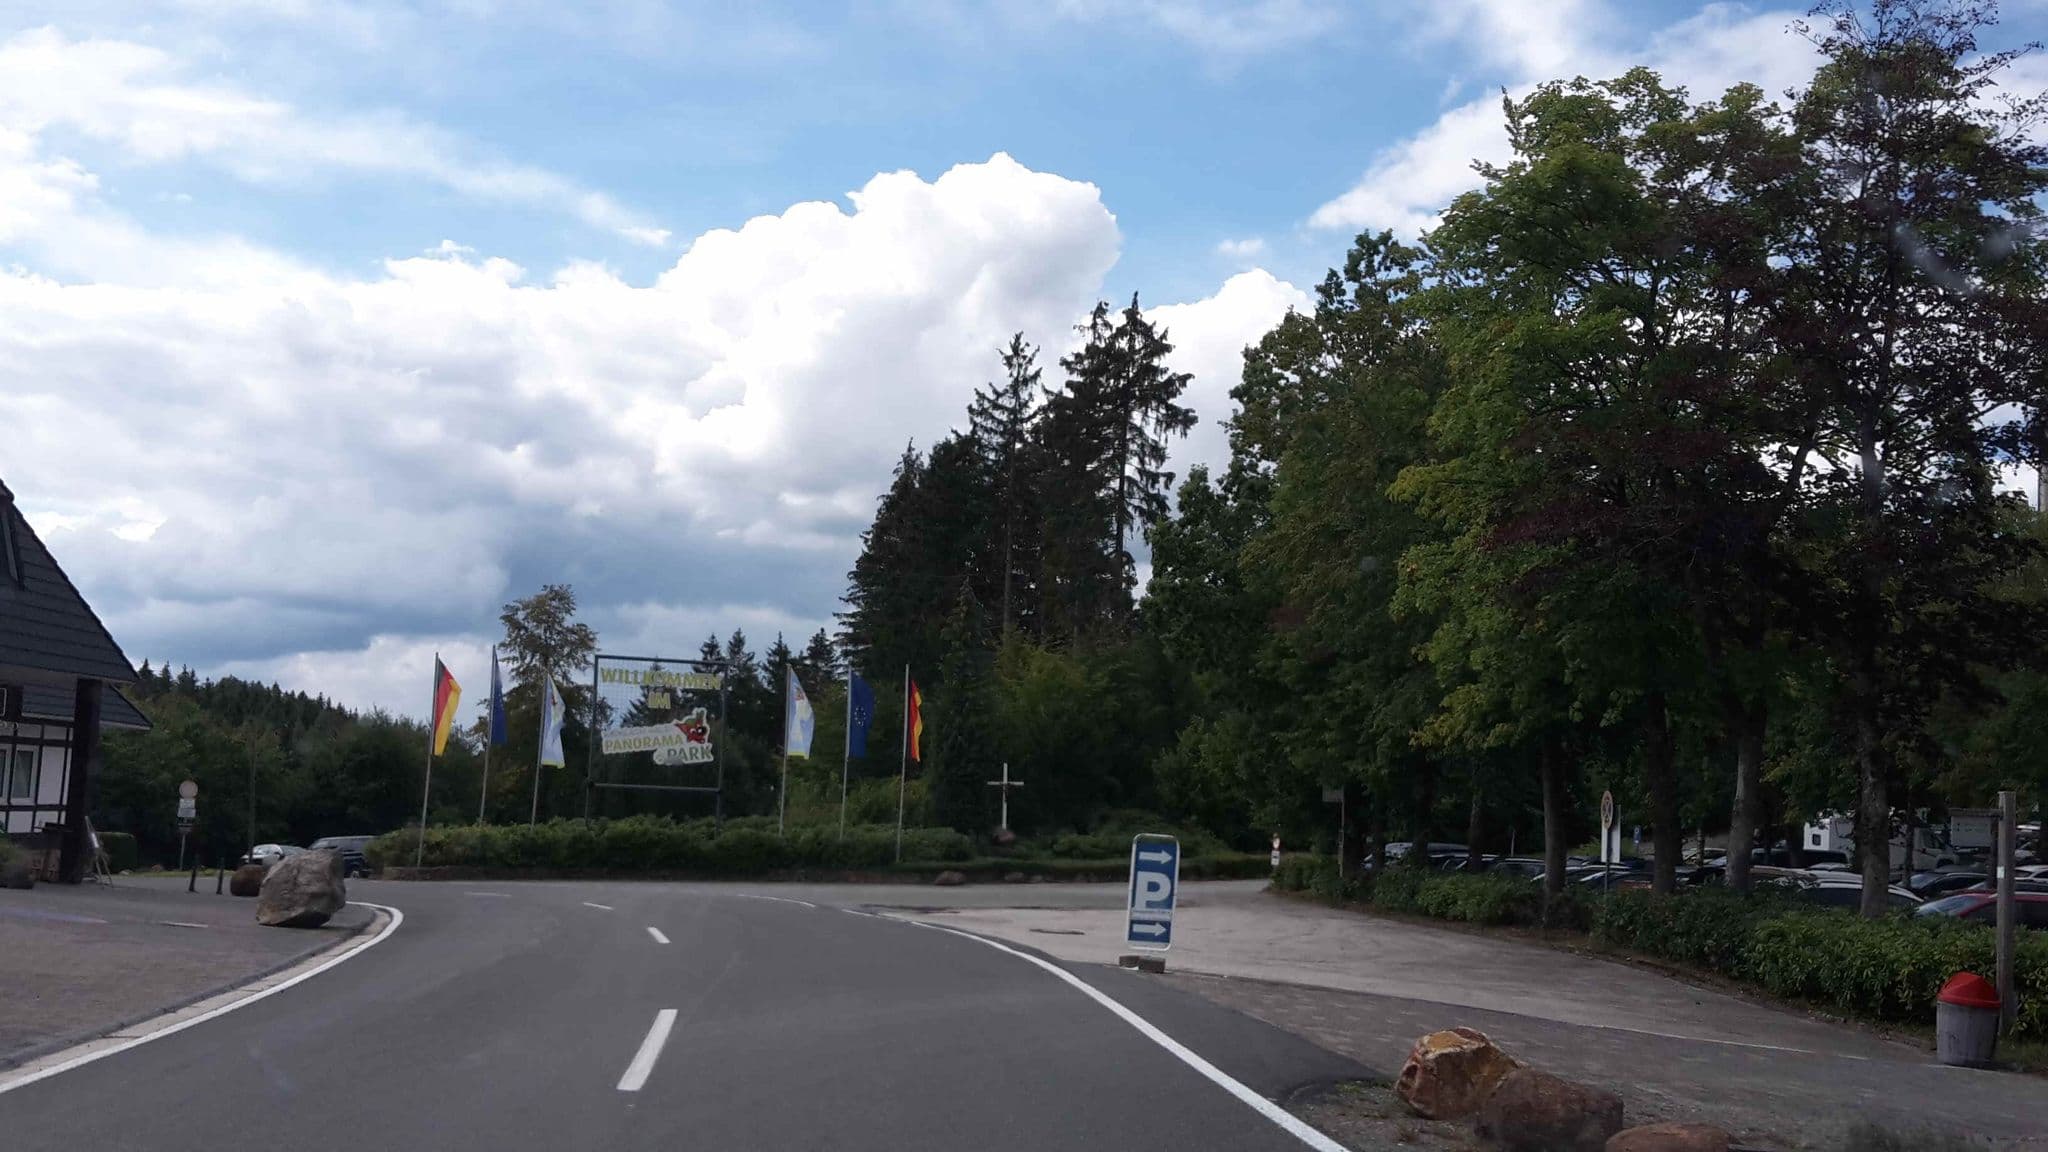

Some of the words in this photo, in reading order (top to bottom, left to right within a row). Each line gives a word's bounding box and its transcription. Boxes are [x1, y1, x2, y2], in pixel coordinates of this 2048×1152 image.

[601, 668, 722, 690] WILLKOMMEN
[648, 691, 671, 709] IM
[605, 735, 683, 752] PANORAMA
[667, 747, 713, 762] PARK
[1134, 870, 1172, 911] P
